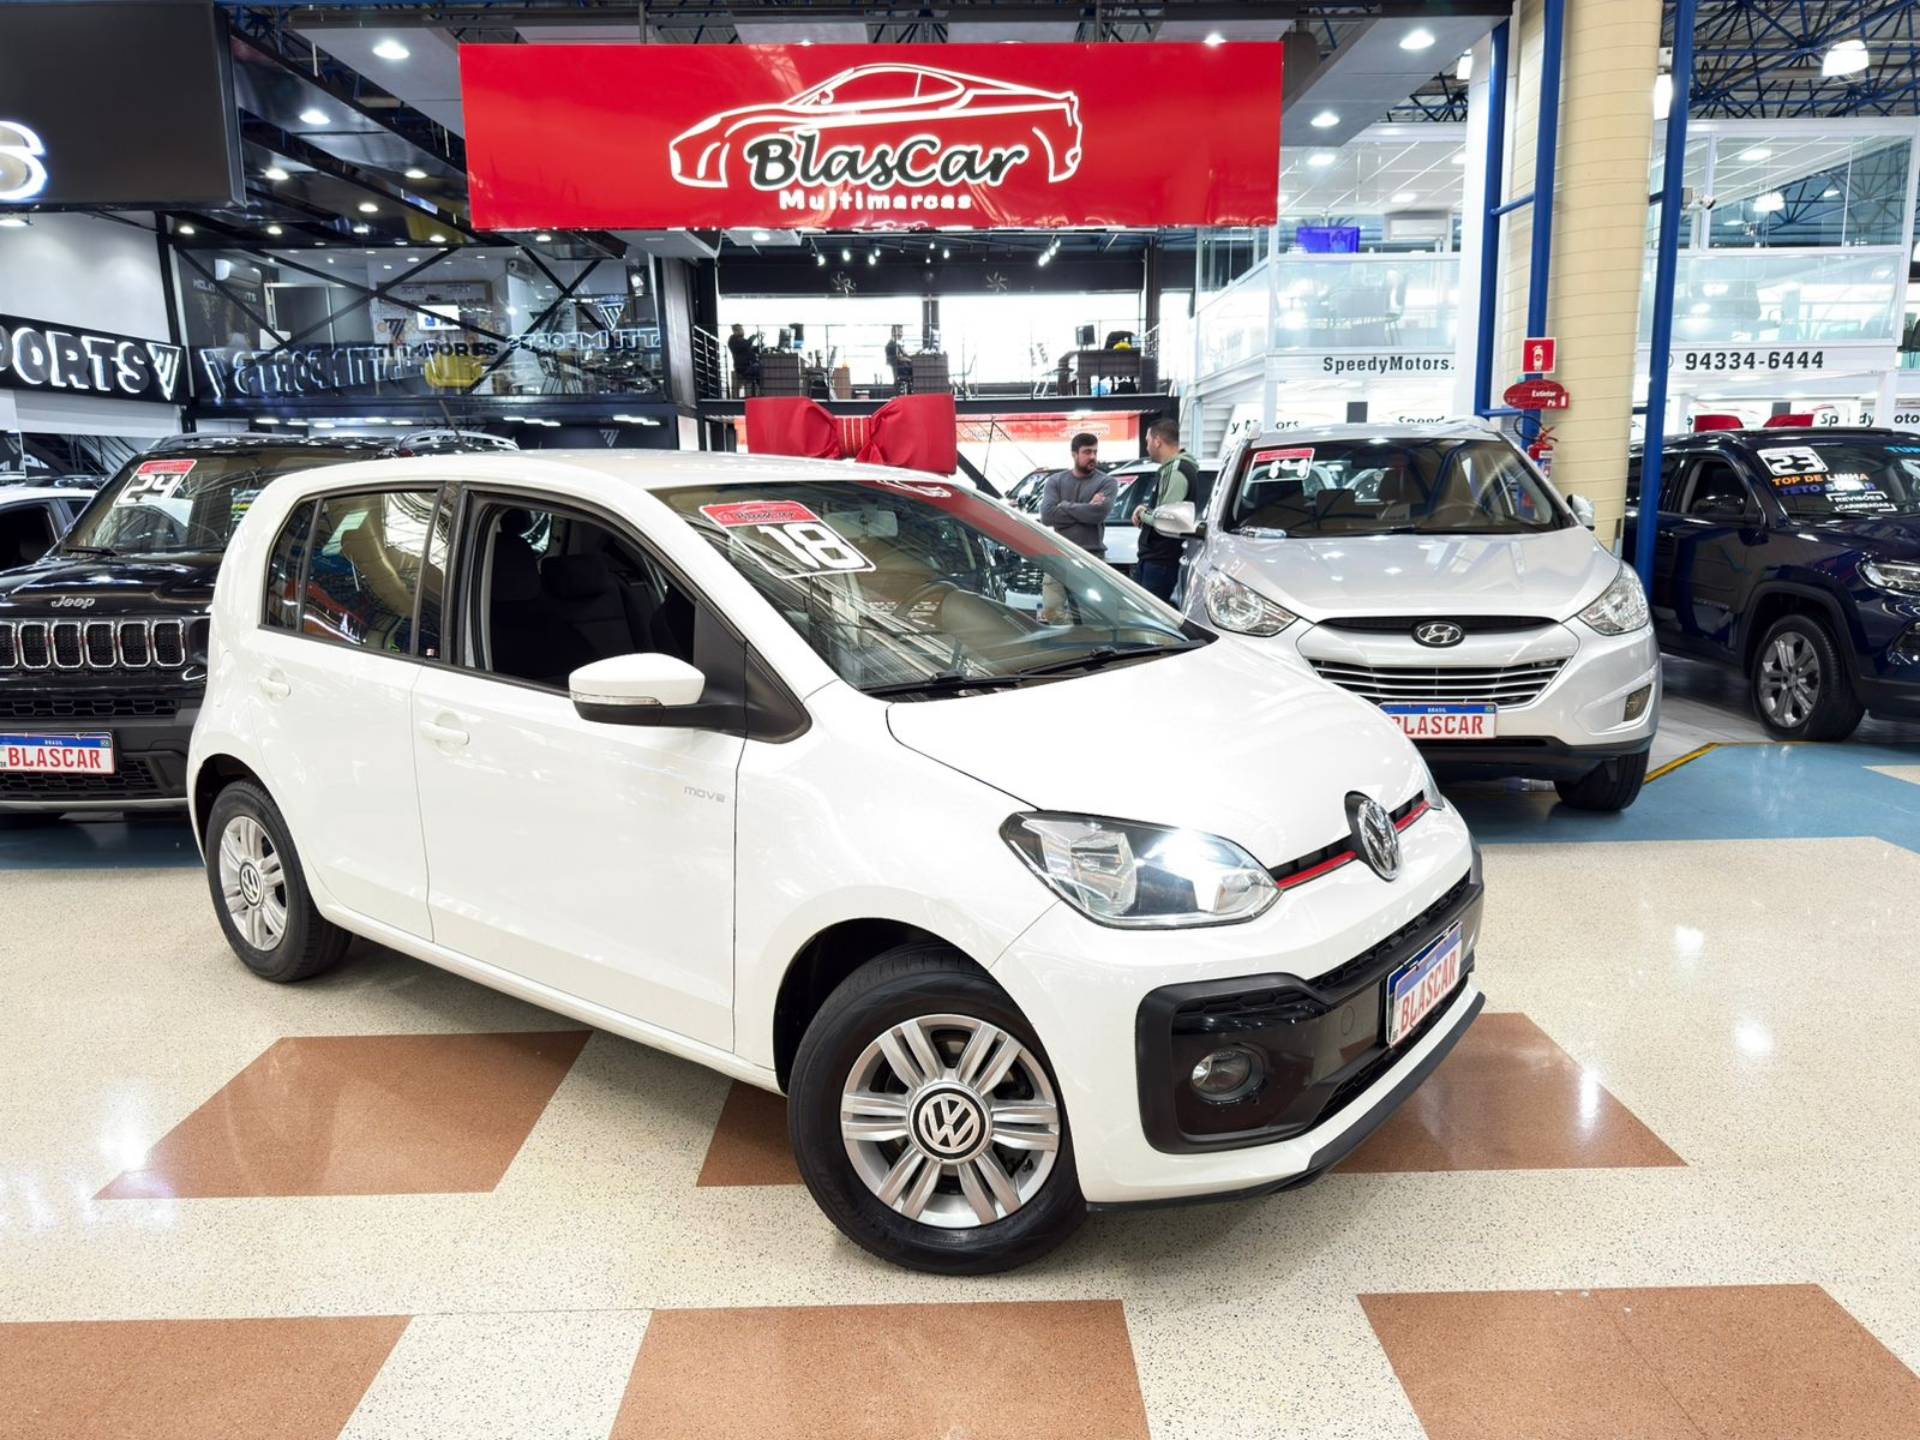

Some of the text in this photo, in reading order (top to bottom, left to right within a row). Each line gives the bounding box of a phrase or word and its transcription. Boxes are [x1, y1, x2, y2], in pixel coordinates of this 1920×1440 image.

[744, 129, 1029, 191] BlasCar
[779, 190, 973, 210] Multimarcas
[1685, 351, 1824, 370] 94334-6444
[1769, 454, 1823, 474] 23
[119, 475, 181, 503] 24
[1772, 472, 1870, 487] TOP DE LINHA
[1781, 484, 1821, 496] TETO
[757, 523, 866, 569] 18
[50, 595, 97, 610] Jeep
[7, 747, 102, 769] BLASCAR
[683, 786, 726, 803] move
[1400, 950, 1457, 1033] BLASCAR
